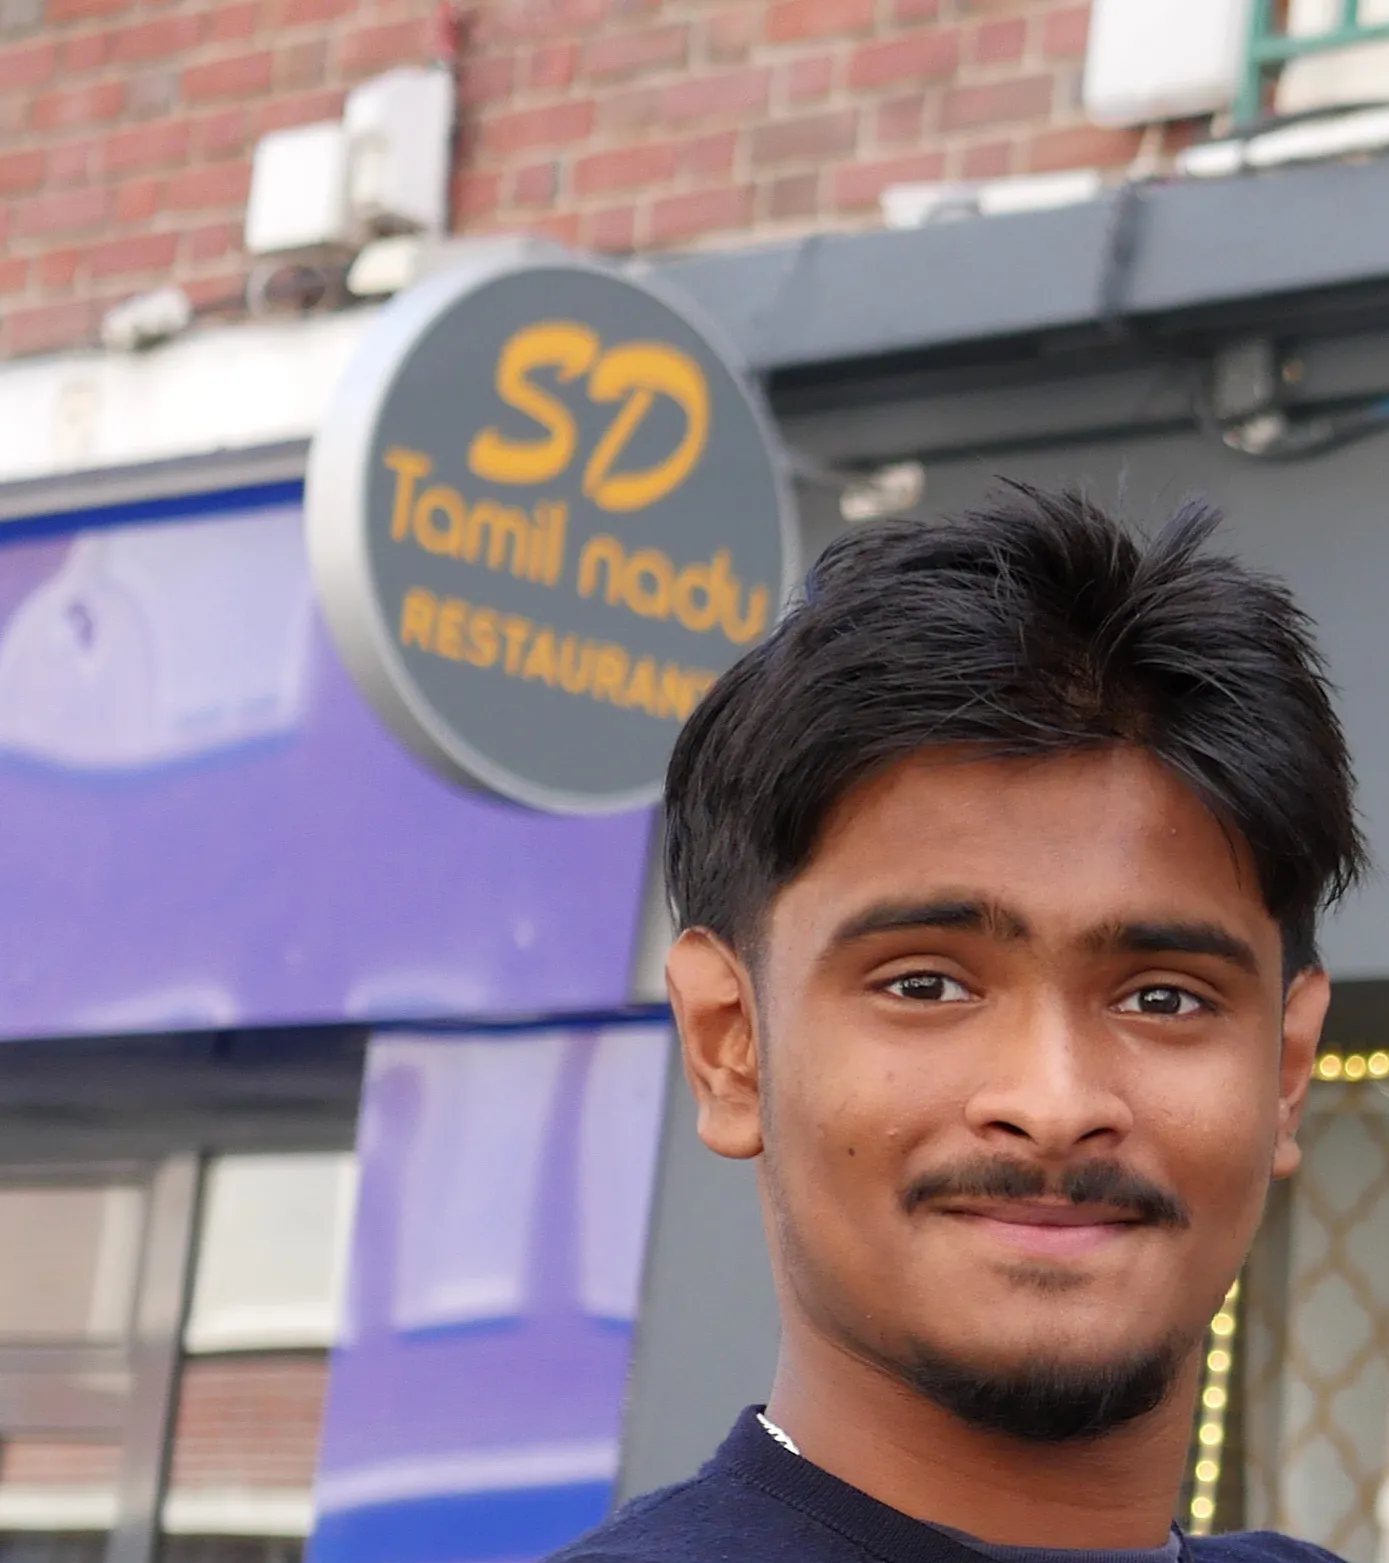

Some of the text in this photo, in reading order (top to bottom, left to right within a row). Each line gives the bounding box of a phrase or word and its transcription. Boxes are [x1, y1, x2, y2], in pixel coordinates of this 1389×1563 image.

[469, 321, 711, 511] SD
[384, 447, 771, 644] Tamil nadu
